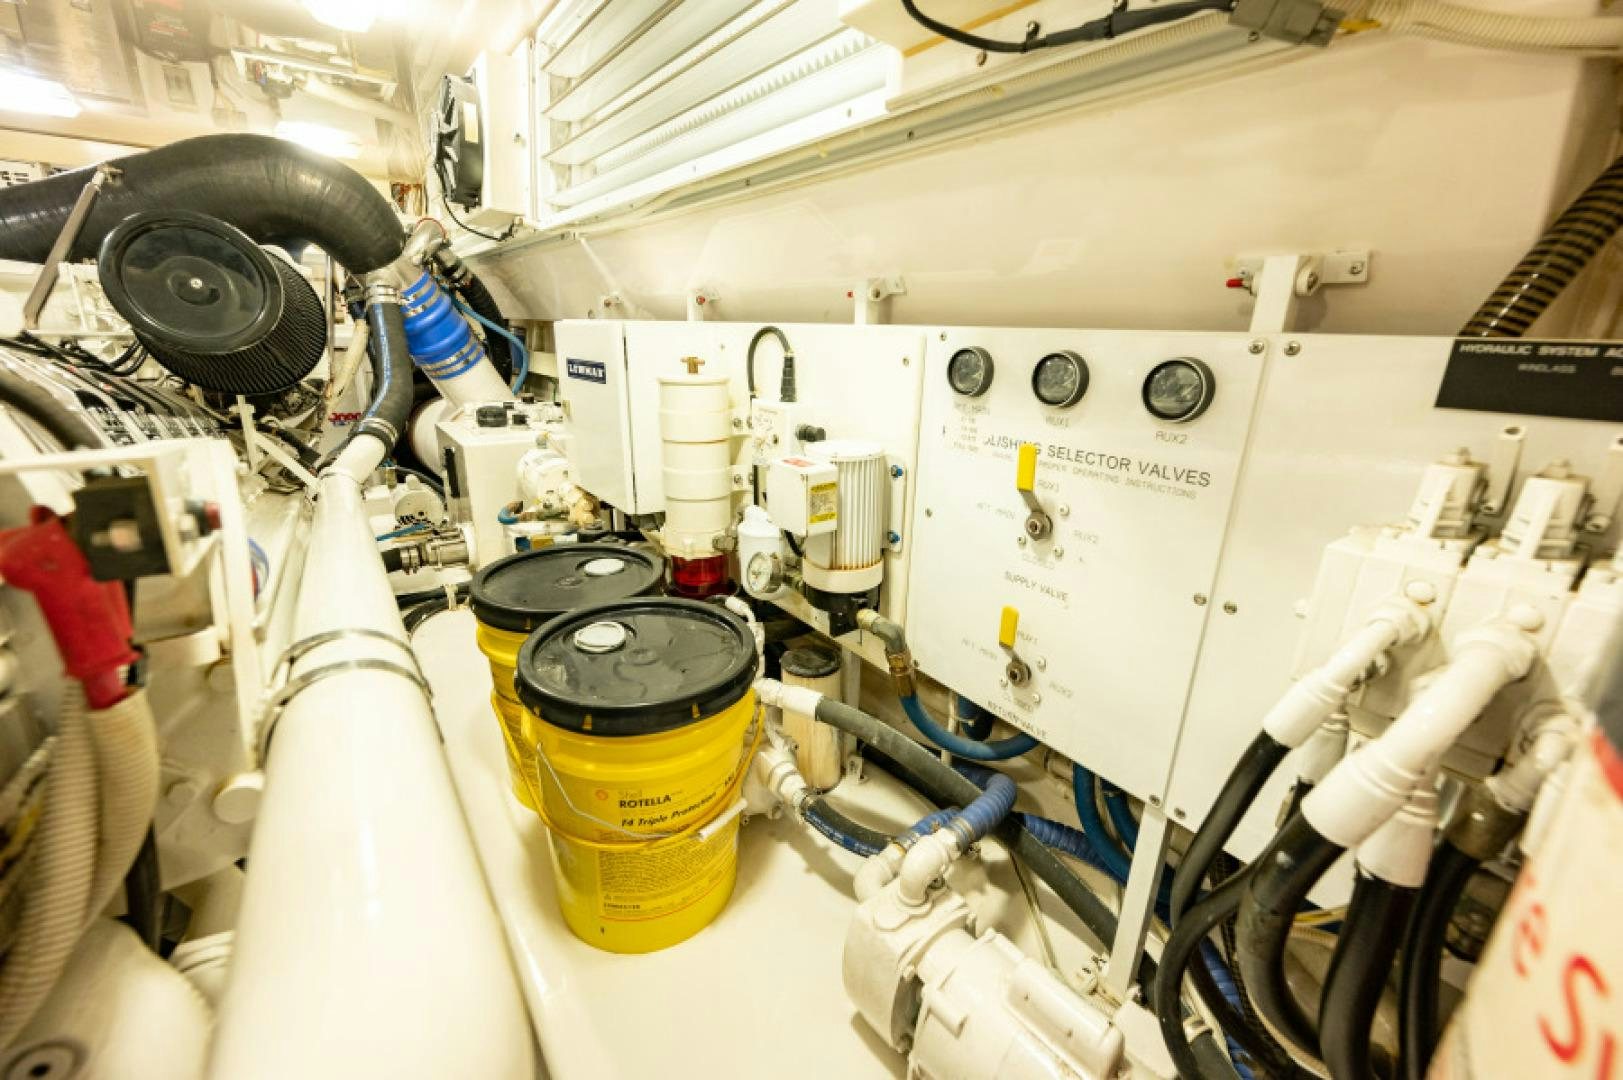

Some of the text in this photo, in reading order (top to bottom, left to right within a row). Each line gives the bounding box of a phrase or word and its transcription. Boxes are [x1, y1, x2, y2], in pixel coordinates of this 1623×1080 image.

[1458, 343, 1533, 356] HYDRAULIC
[1537, 345, 1600, 358] SYSTEM
[1155, 430, 1188, 445] AUX2
[1047, 444, 1131, 472] SELECTOR
[1138, 460, 1211, 488] VALVES
[1125, 477, 1198, 500] INSTRUCTIONS
[1004, 571, 1070, 602] SUPPLY VALVE
[618, 794, 672, 810] ROTELLA
[638, 813, 668, 828] Triple
